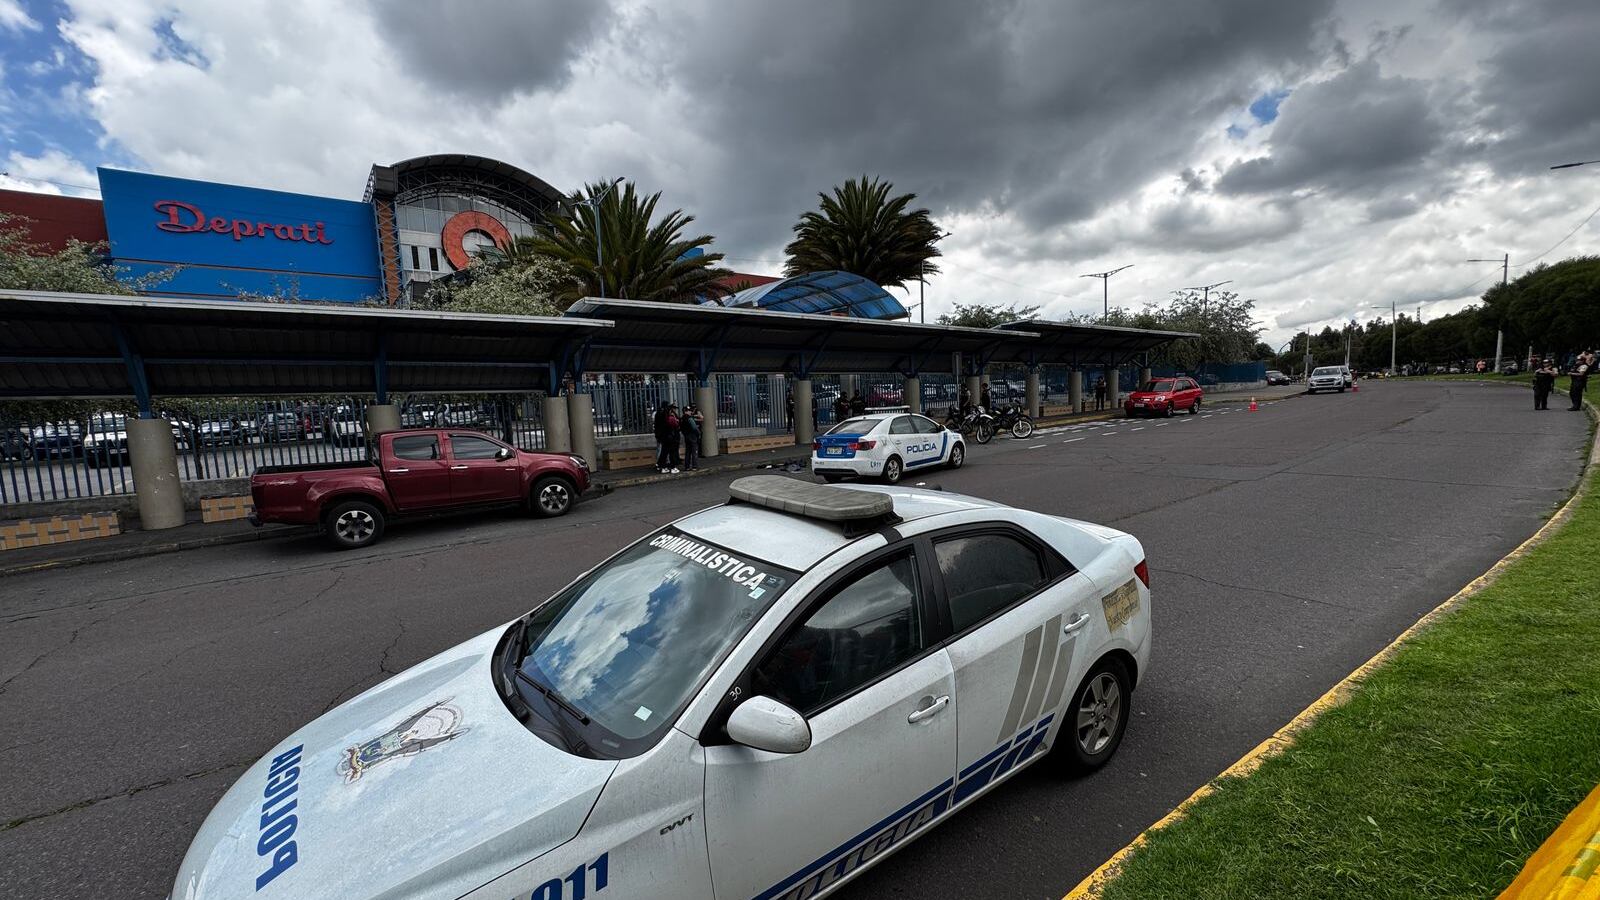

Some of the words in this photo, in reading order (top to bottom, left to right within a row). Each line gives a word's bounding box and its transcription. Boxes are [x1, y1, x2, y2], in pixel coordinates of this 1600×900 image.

[154, 200, 335, 245] Deprati
[906, 441, 937, 455] POLICIA
[649, 534, 767, 590] CRIMINALISTICA
[729, 686, 742, 701] 30
[659, 813, 694, 836] CVVT
[784, 802, 935, 900] OLICIA
